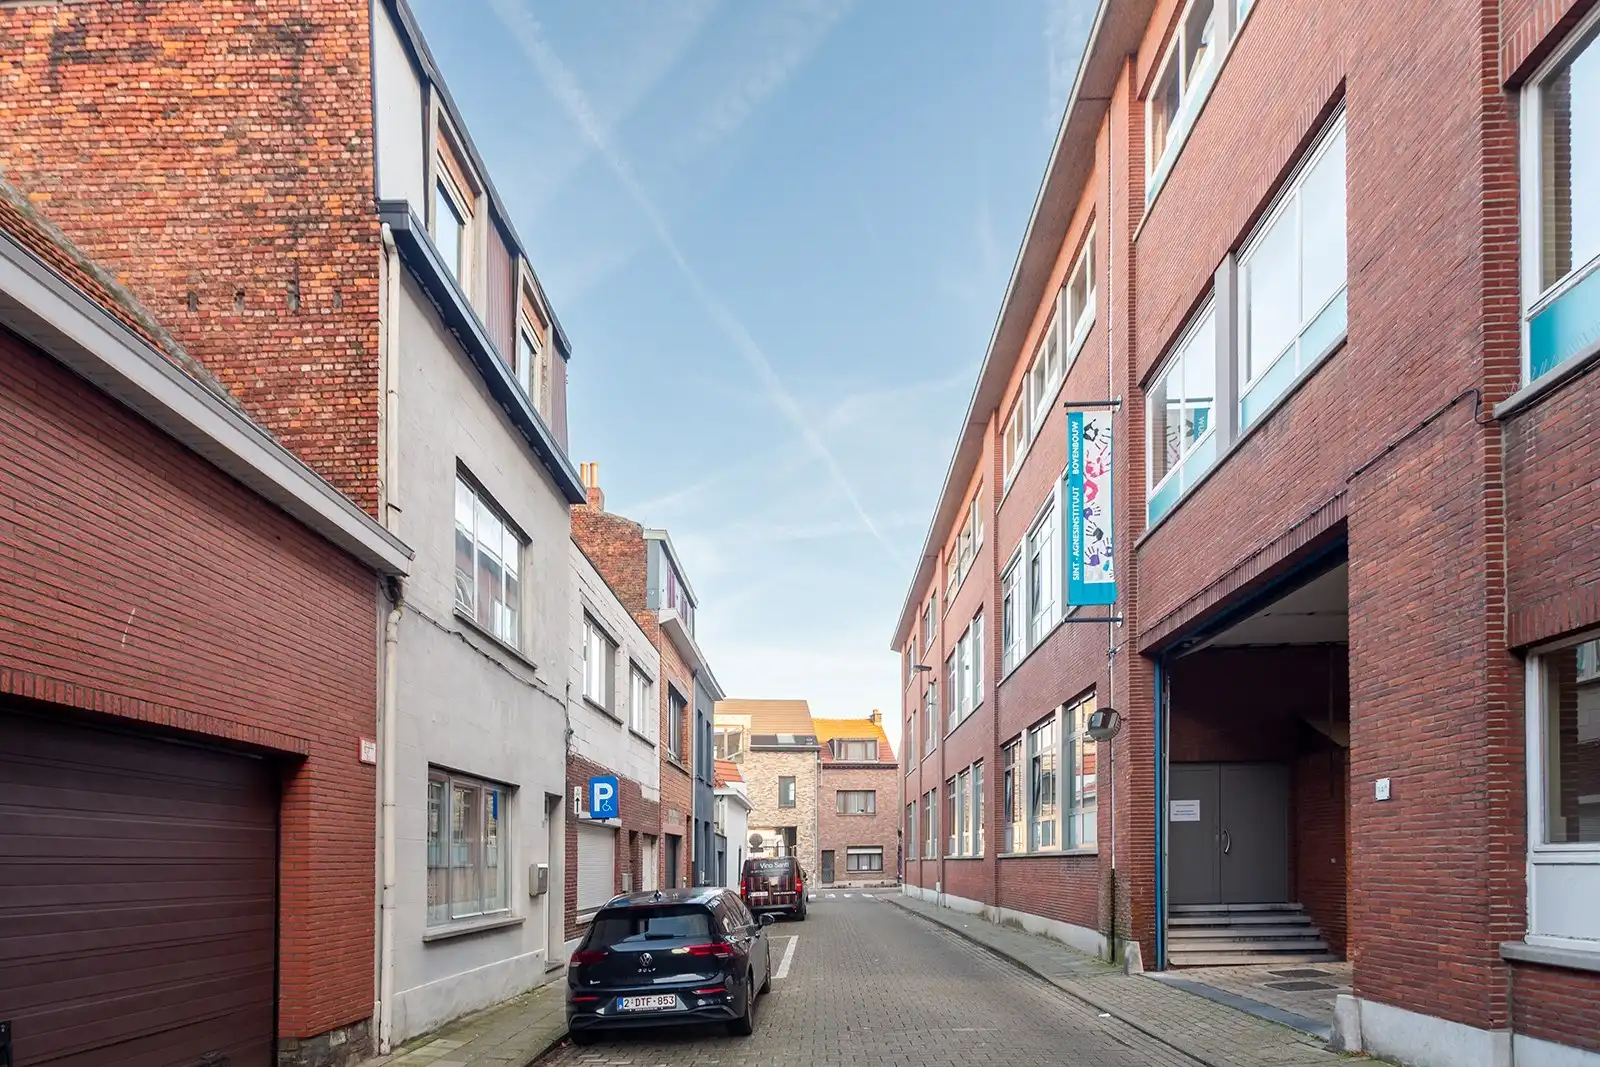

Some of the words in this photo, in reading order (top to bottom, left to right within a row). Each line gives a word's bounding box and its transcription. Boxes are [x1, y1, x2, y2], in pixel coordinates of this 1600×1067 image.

[1071, 421, 1079, 475] BOVENBOUW
[1072, 486, 1080, 557] AGNESINSTITUUT
[1072, 562, 1080, 581] SINT
[594, 783, 613, 811] P
